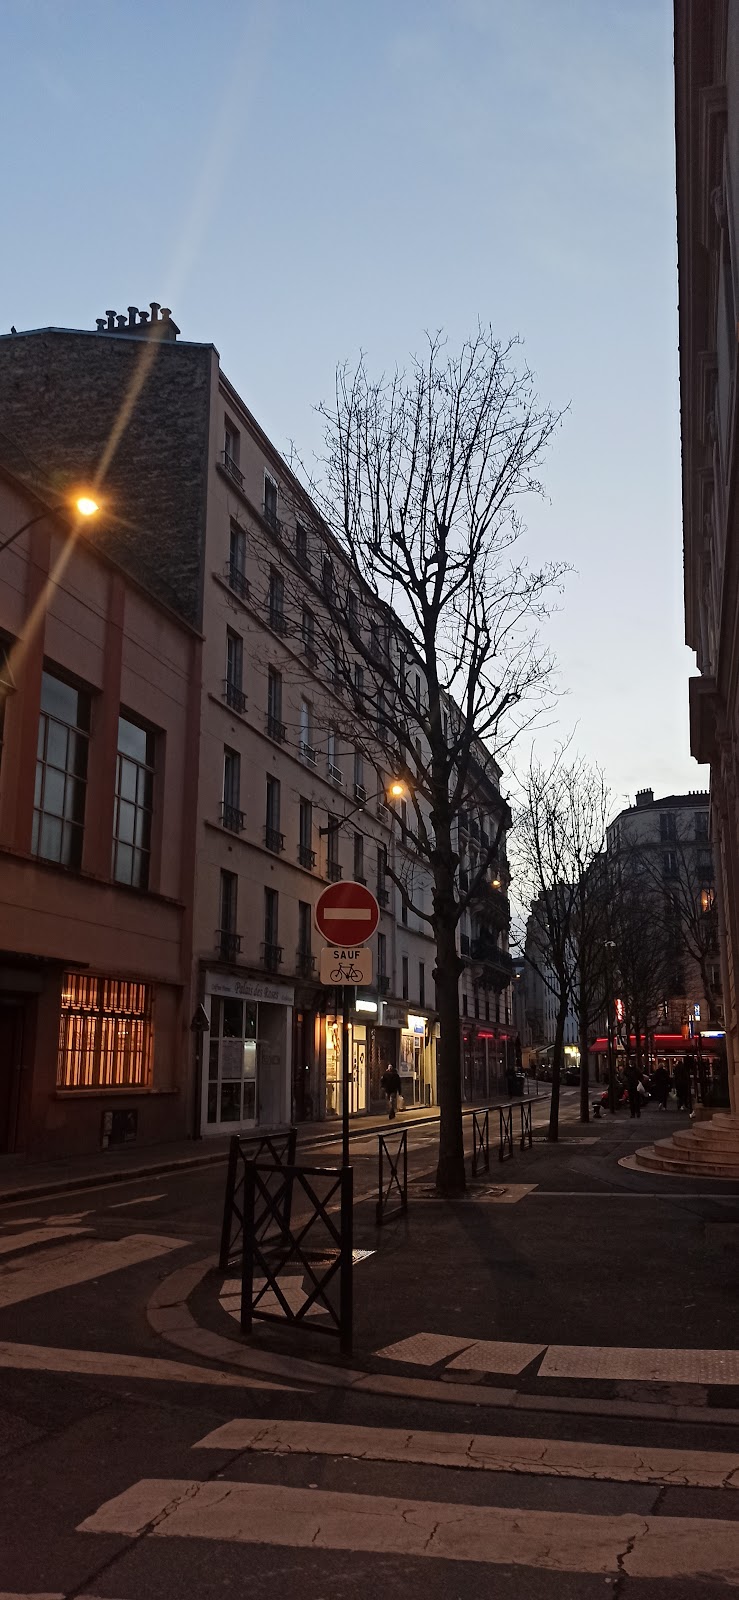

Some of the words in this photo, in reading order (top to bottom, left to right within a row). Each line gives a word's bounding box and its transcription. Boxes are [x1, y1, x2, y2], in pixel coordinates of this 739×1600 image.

[333, 950, 361, 960] SAUF
[234, 981, 253, 995] Palais
[253, 983, 263, 997] des
